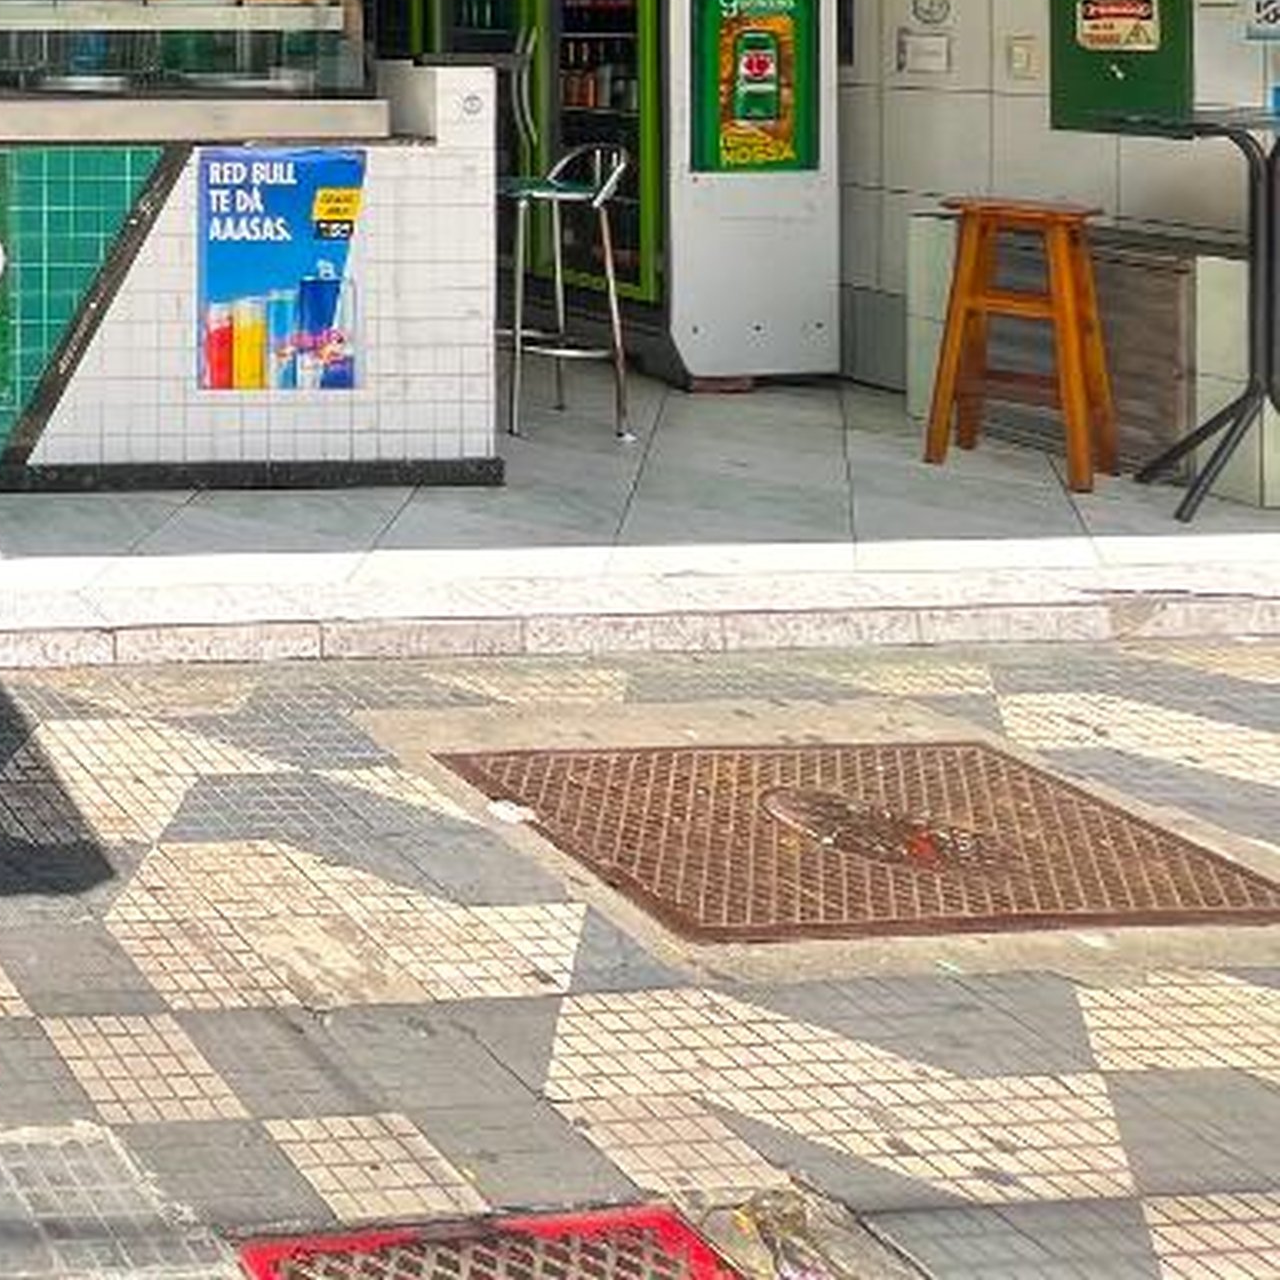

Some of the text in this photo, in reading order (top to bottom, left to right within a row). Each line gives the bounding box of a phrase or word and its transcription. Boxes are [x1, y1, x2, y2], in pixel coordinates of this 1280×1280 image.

[209, 162, 297, 184] RED BULL
[209, 187, 265, 213] TE DÁ
